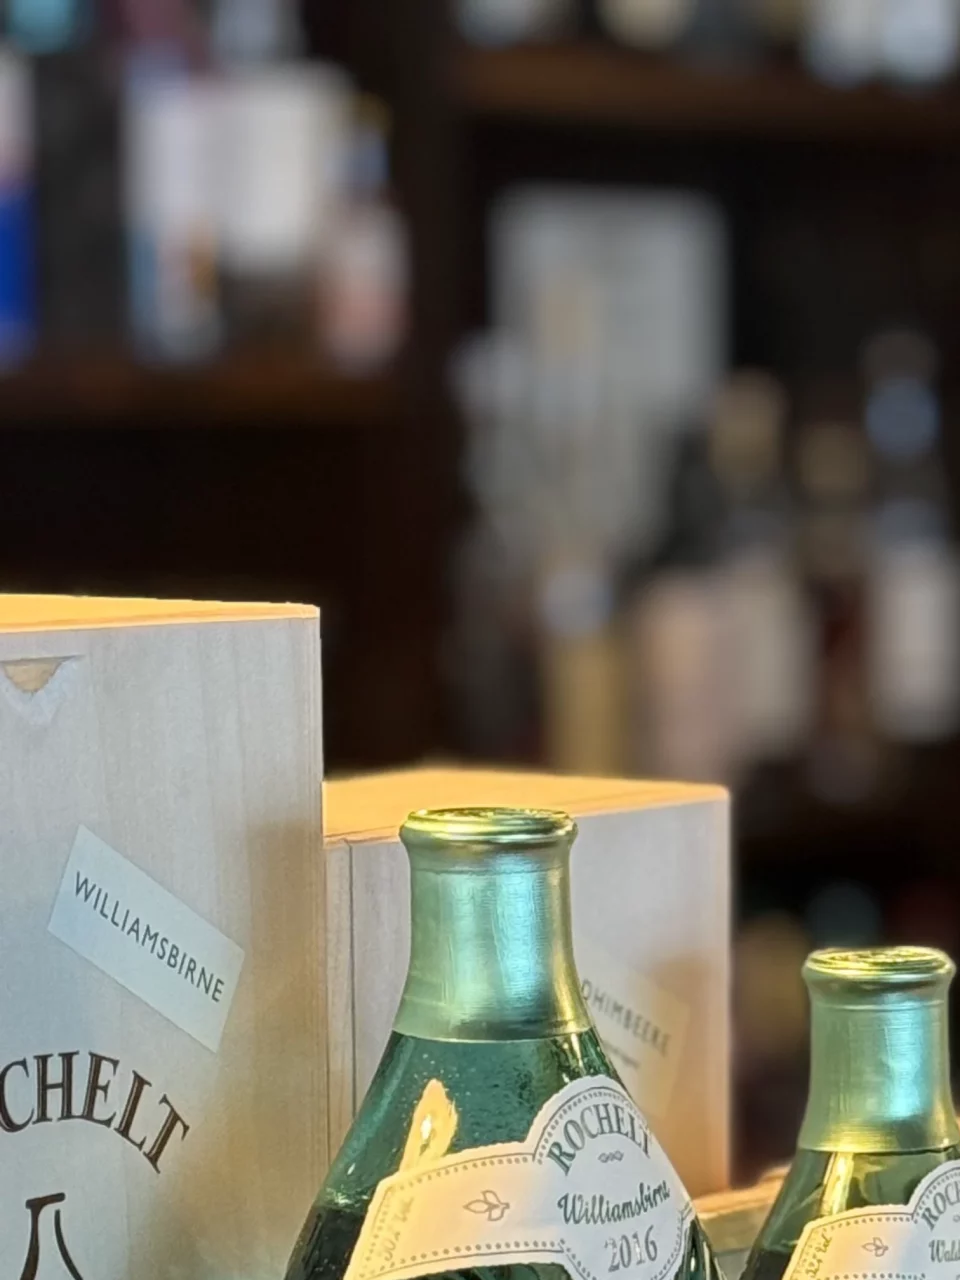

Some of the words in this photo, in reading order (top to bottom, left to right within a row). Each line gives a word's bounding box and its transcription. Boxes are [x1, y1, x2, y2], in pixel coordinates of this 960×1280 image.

[75, 871, 225, 1003] WILLIAMSBIRNE
[548, 1102, 653, 1177] ROCHELT
[604, 1225, 659, 1273] 2016
